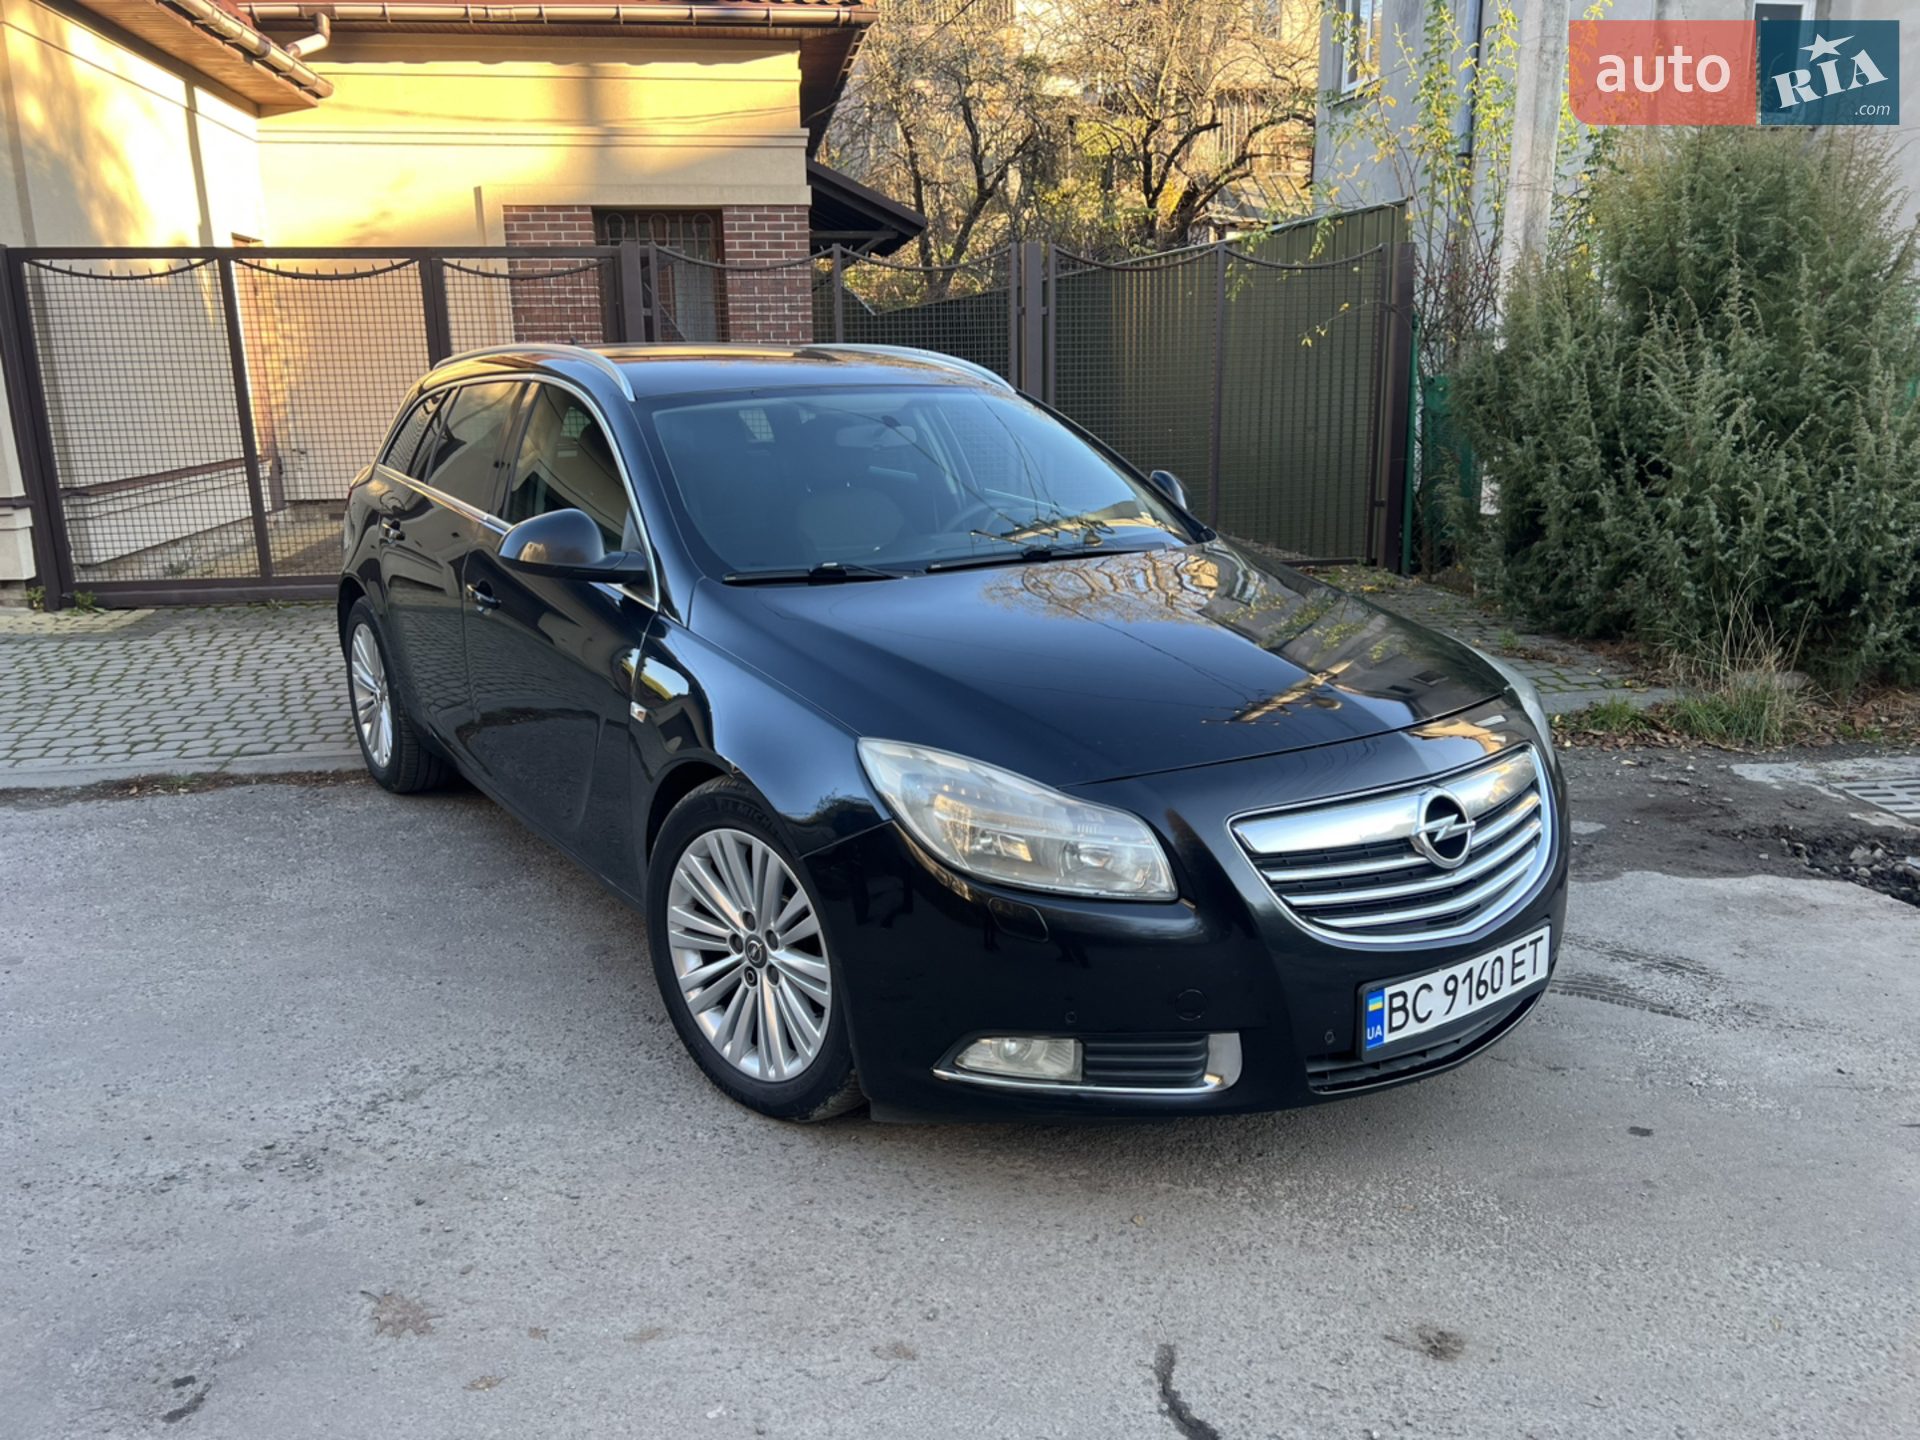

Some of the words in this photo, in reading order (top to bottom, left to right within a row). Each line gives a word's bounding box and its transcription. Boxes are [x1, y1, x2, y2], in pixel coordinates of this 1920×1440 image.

[1387, 983, 1433, 1034] BC
[1443, 956, 1504, 1016] 9160
[1510, 935, 1544, 986] ET
[1367, 1025, 1383, 1040] UA
